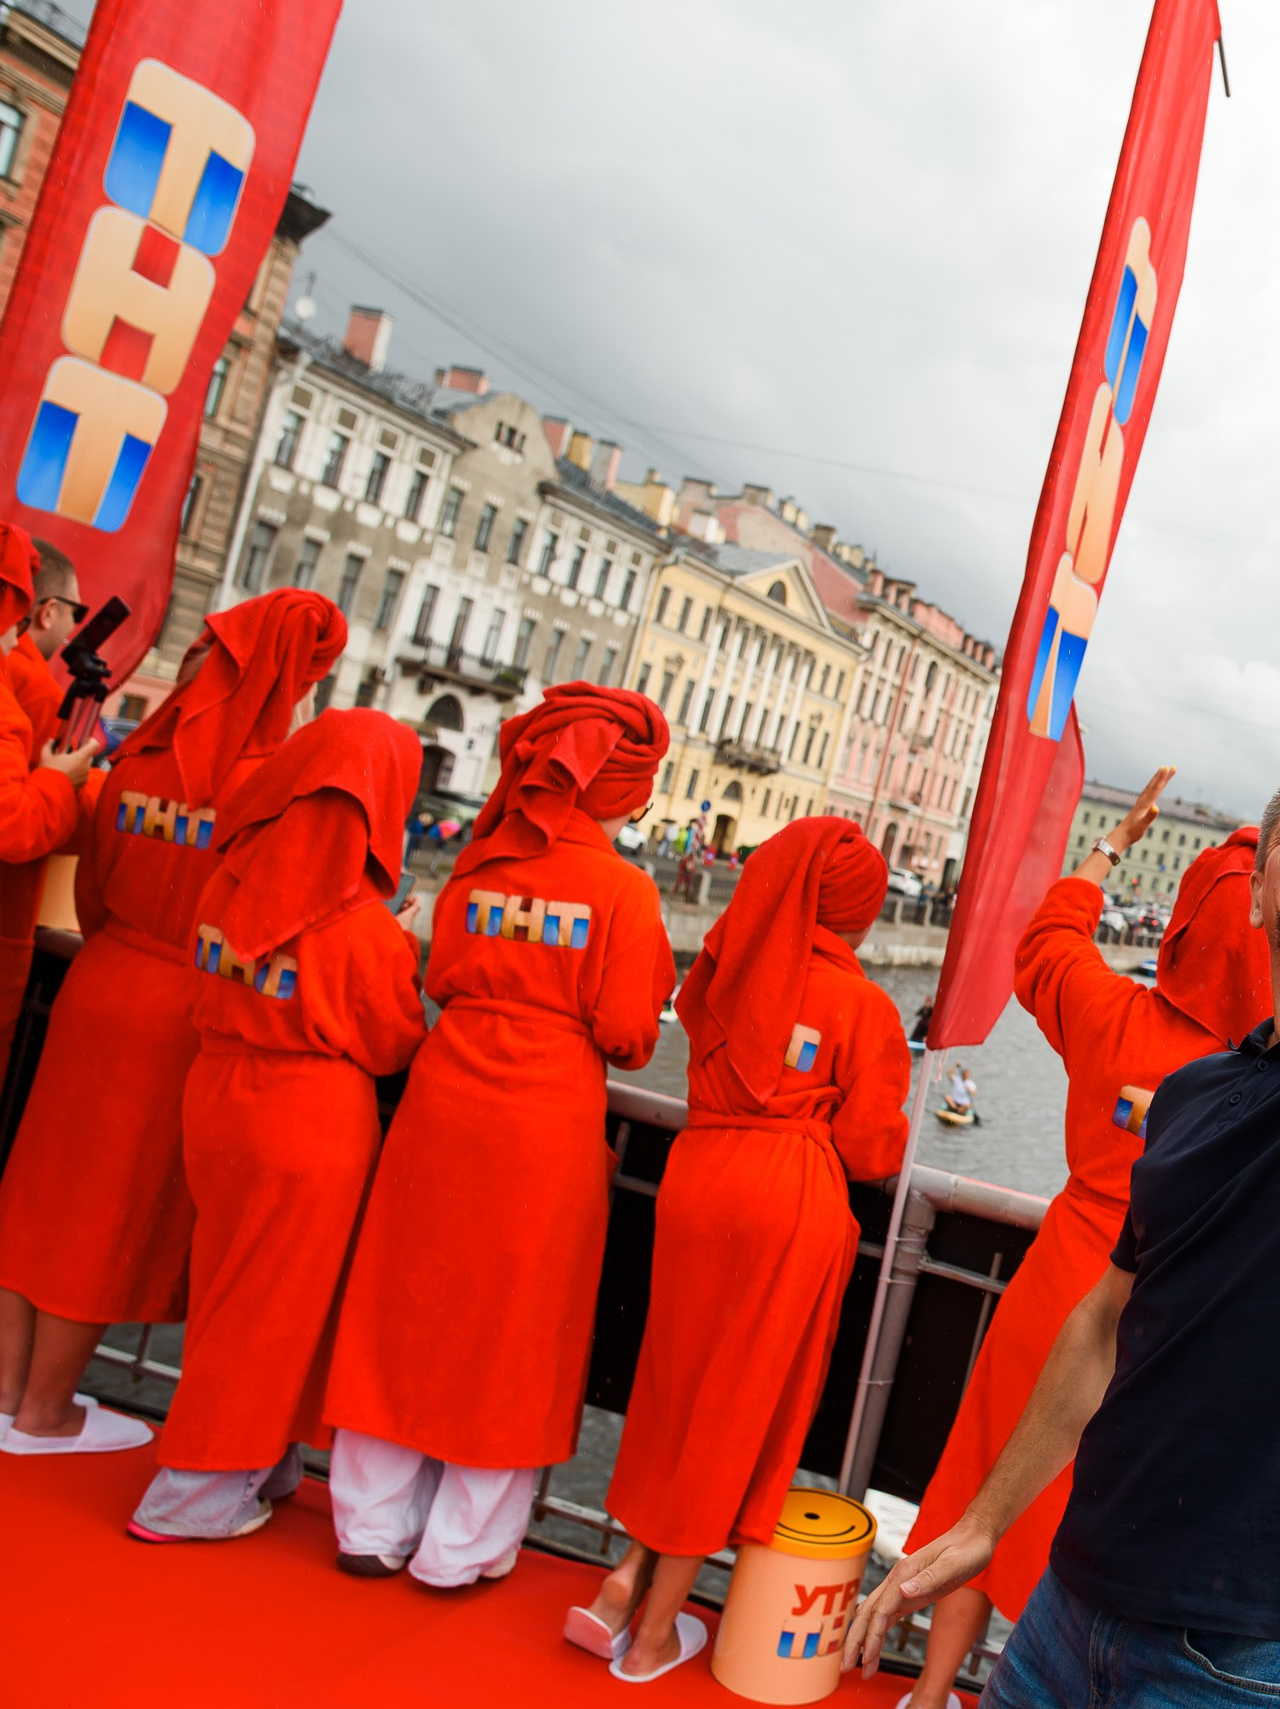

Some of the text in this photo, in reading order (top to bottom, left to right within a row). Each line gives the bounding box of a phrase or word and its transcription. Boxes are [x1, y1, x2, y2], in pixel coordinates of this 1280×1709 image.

[16, 58, 256, 533] ТНТ
[116, 790, 215, 850] ТНТ
[466, 888, 592, 950] ТНТ
[777, 1615, 853, 1659] ТН
